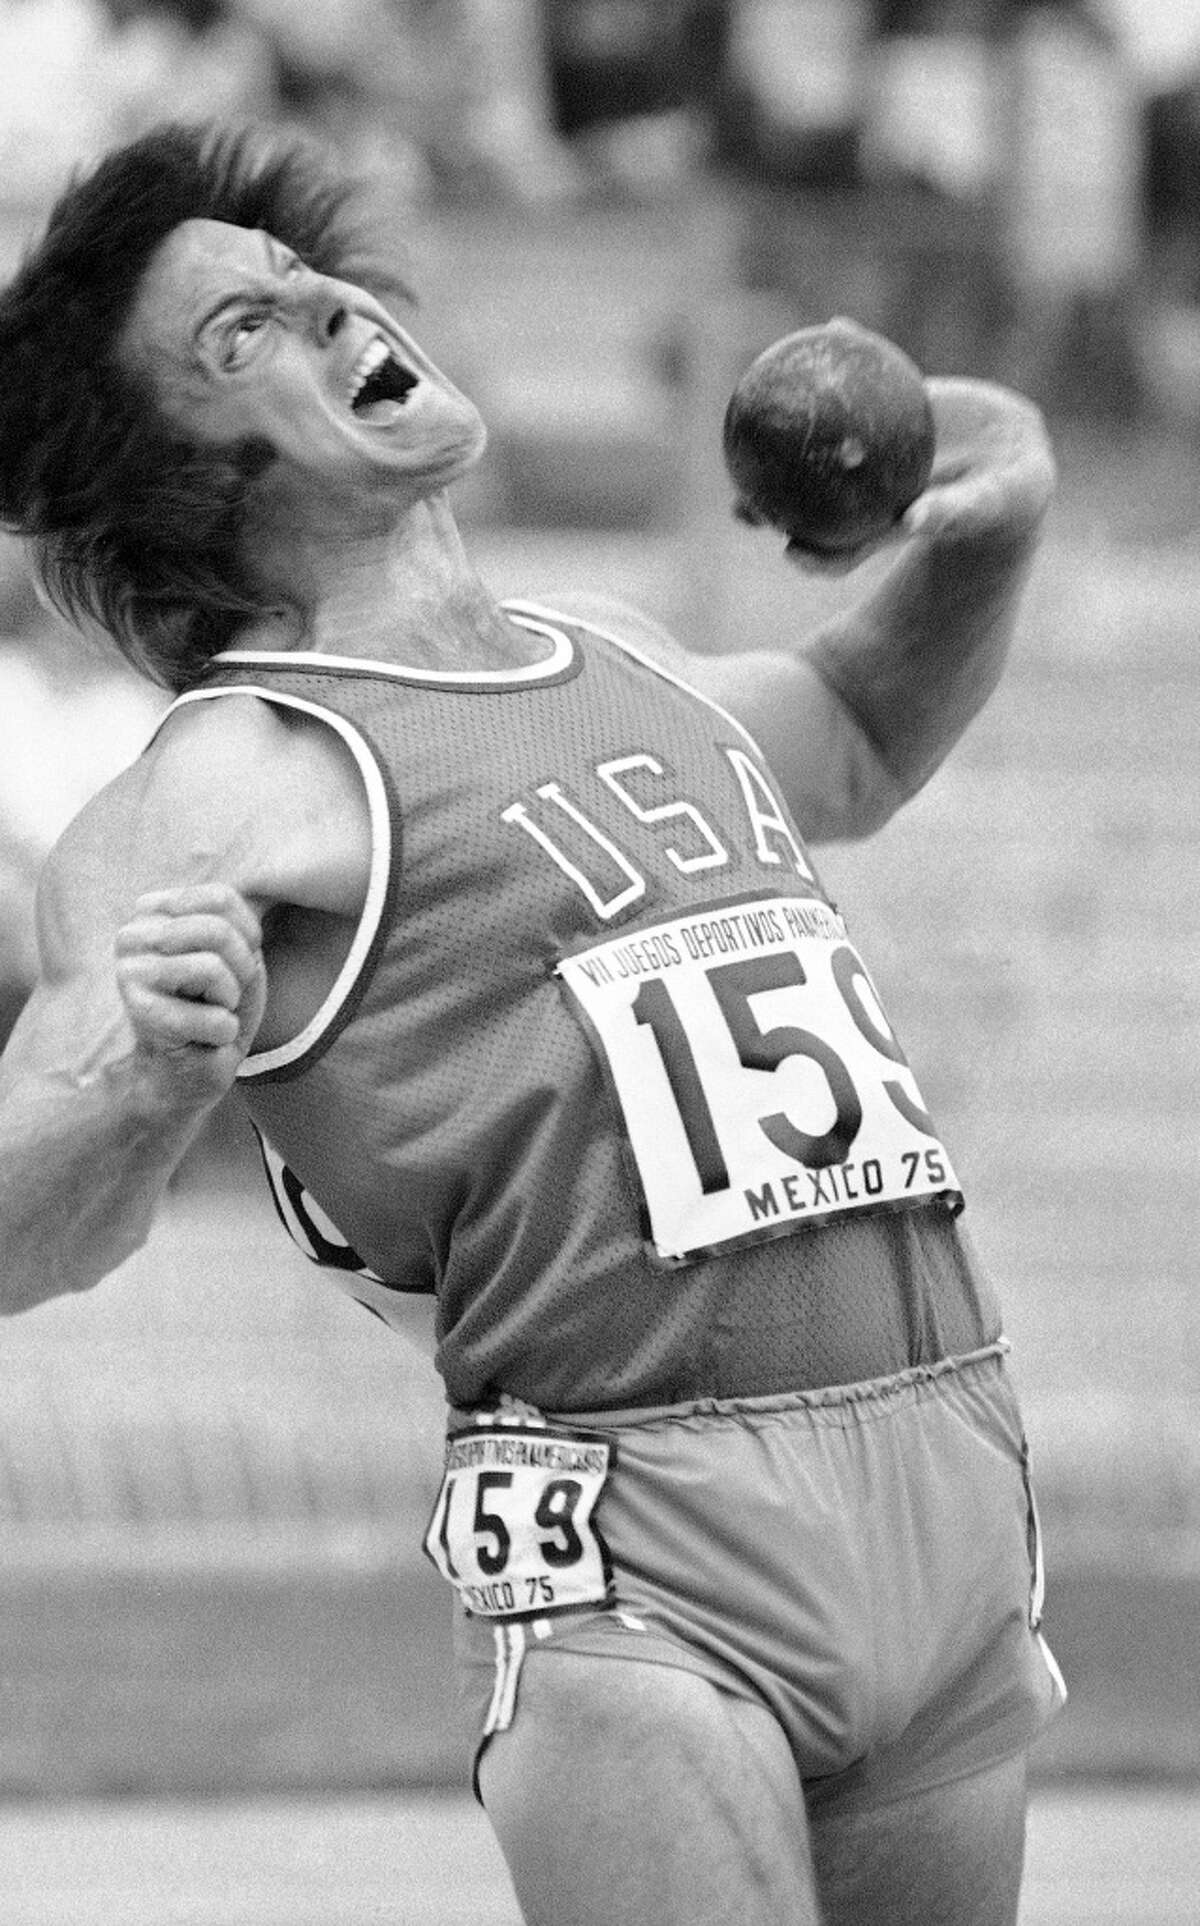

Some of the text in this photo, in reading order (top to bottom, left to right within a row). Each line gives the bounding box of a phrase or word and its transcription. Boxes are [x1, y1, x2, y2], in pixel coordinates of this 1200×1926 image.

[502, 747, 814, 919] USA
[578, 949, 615, 987] VII
[611, 932, 682, 978] JUEGOS
[681, 909, 784, 960] DEPORTIVOS
[631, 946, 941, 1195] 159
[744, 1149, 946, 1222] MEXICO 75
[463, 1574, 555, 1611] EXICO 75
